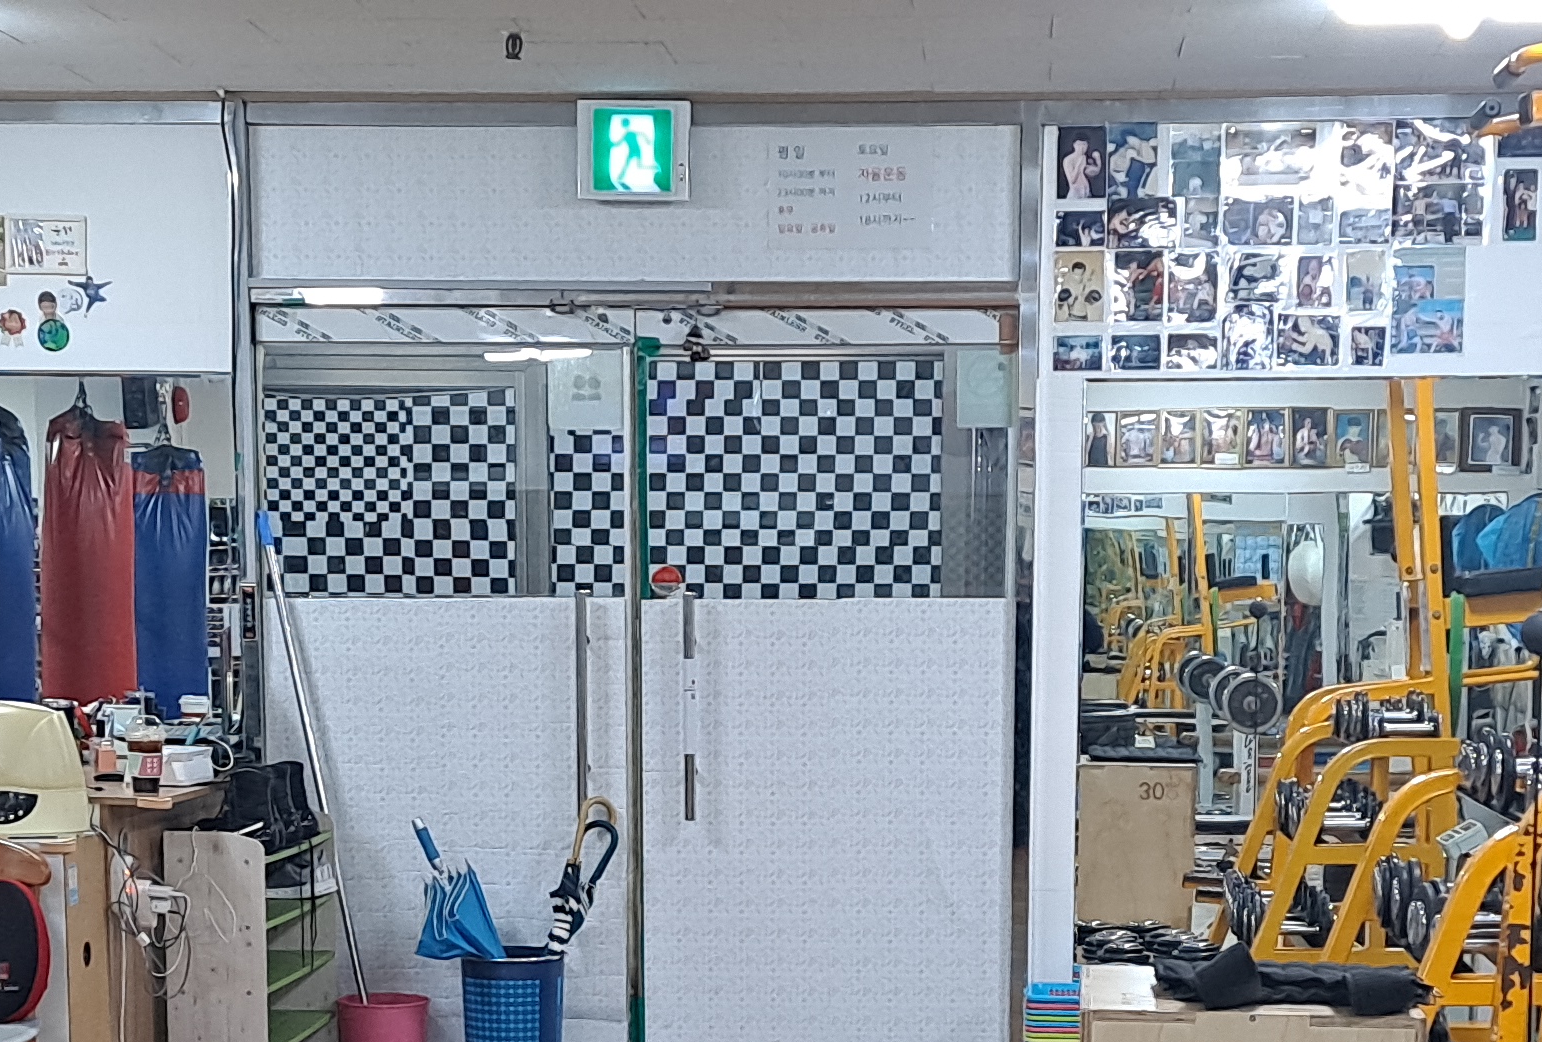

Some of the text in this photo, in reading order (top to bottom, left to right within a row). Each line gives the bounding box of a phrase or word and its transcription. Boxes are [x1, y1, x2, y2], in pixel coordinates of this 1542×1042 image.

[858, 144, 889, 156] 토요일
[858, 166, 907, 182] 자율운동
[859, 192, 903, 205] 12시부터
[1139, 781, 1165, 800] 30
